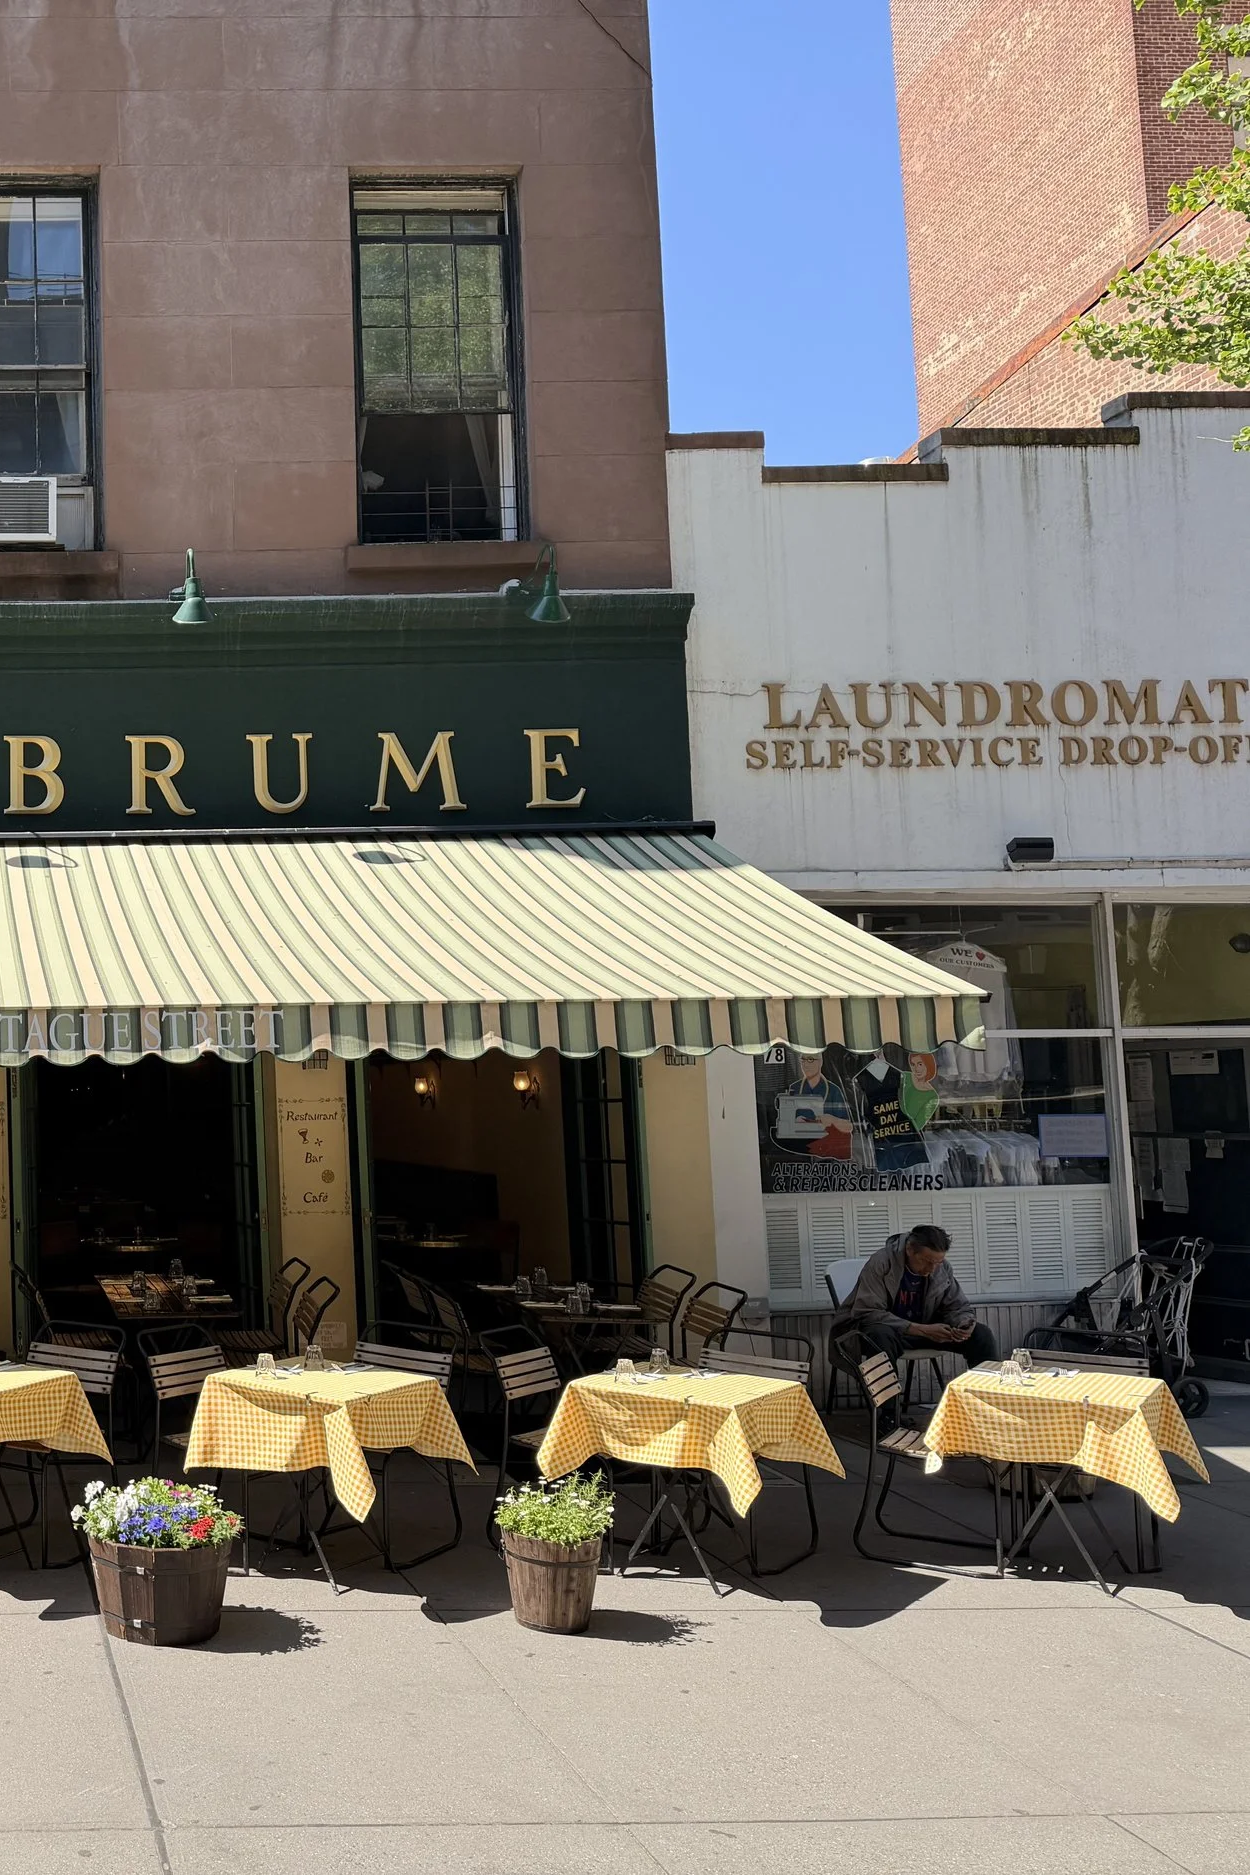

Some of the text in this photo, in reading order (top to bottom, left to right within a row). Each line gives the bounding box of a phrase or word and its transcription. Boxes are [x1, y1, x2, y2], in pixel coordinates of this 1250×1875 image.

[761, 678, 1248, 730] LAUNDROMAT
[746, 735, 1250, 770] SELF-SERVICE DROP-OF
[3, 728, 587, 816] BRUME
[950, 947, 973, 958] WE
[955, 959, 995, 969] CUSTOMERS
[142, 1008, 285, 1051] STREET
[873, 1100, 899, 1115] SAME
[286, 1110, 338, 1121] Restaurant
[879, 1112, 899, 1126] DAY
[873, 1121, 911, 1140] SERVICE
[304, 1151, 324, 1164] Bar
[771, 1162, 858, 1177] ALTERATIONS
[772, 1174, 859, 1193] & REPAIRS
[858, 1173, 944, 1192] CLEANERS
[302, 1191, 328, 1204] Café
